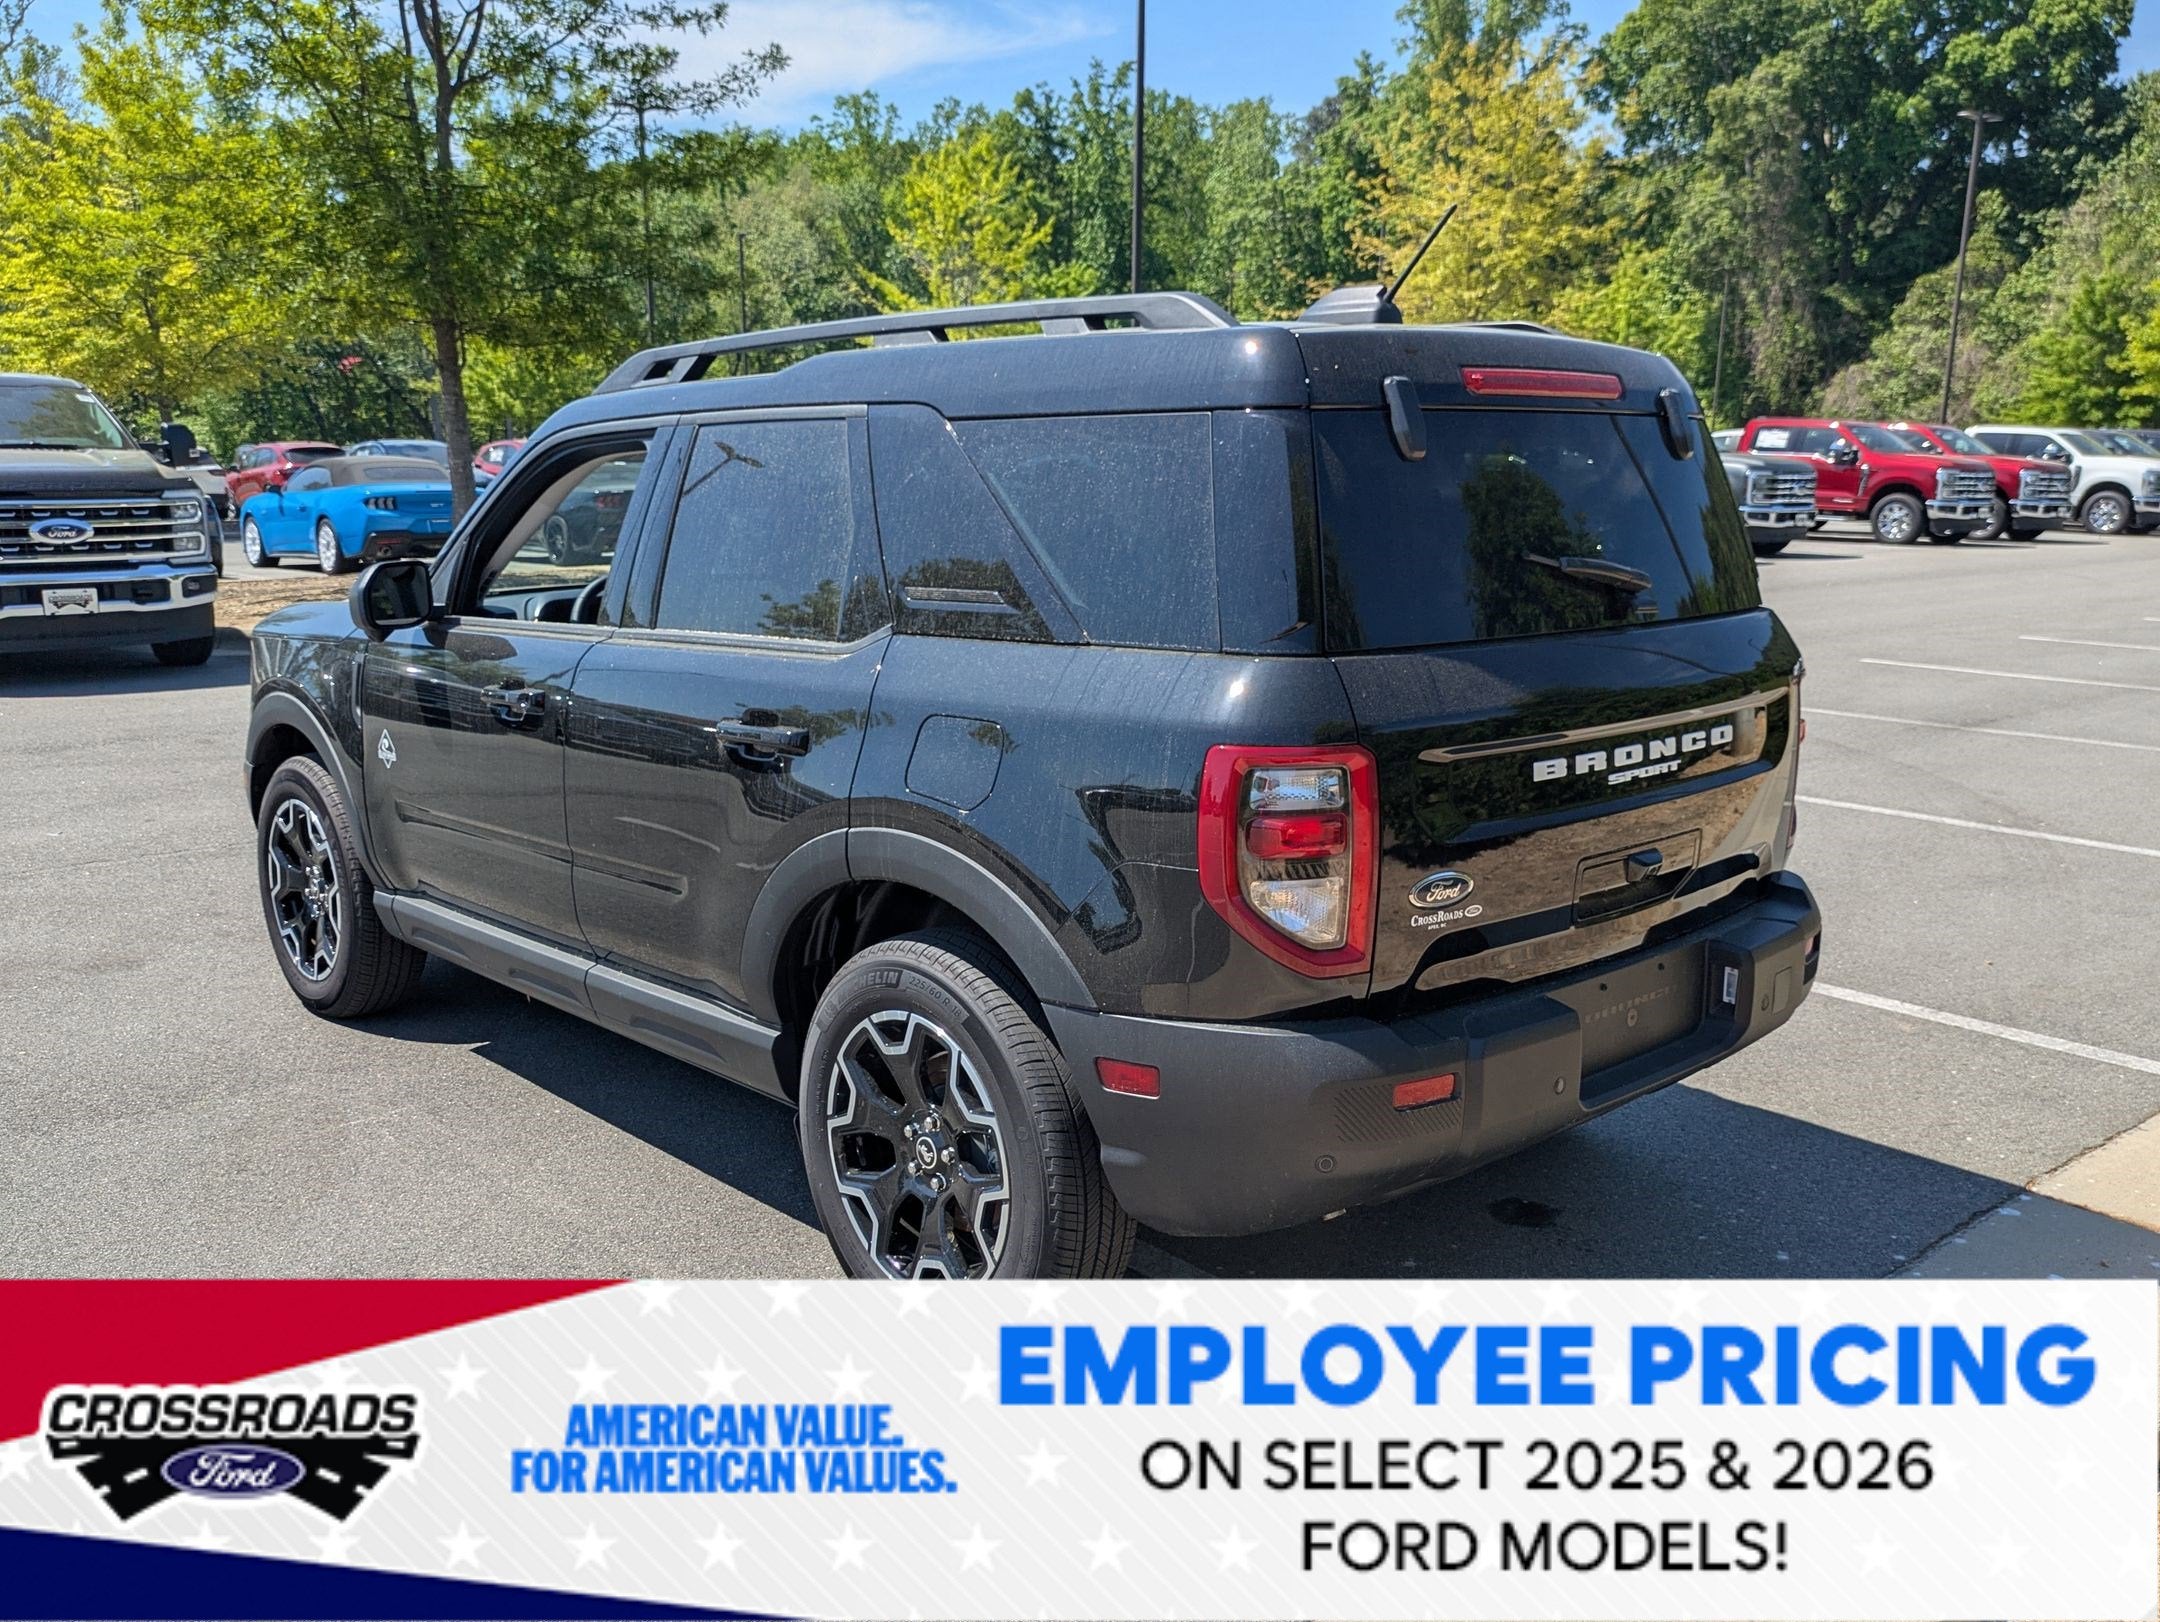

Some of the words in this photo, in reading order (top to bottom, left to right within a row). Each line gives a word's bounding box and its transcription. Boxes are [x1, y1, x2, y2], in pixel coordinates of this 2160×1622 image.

[1533, 724, 1733, 782] BRONCO
[1607, 759, 1682, 785] SPORT
[1426, 880, 1462, 902] Ford
[909, 976, 942, 999] 225/60
[940, 995, 950, 1007] R
